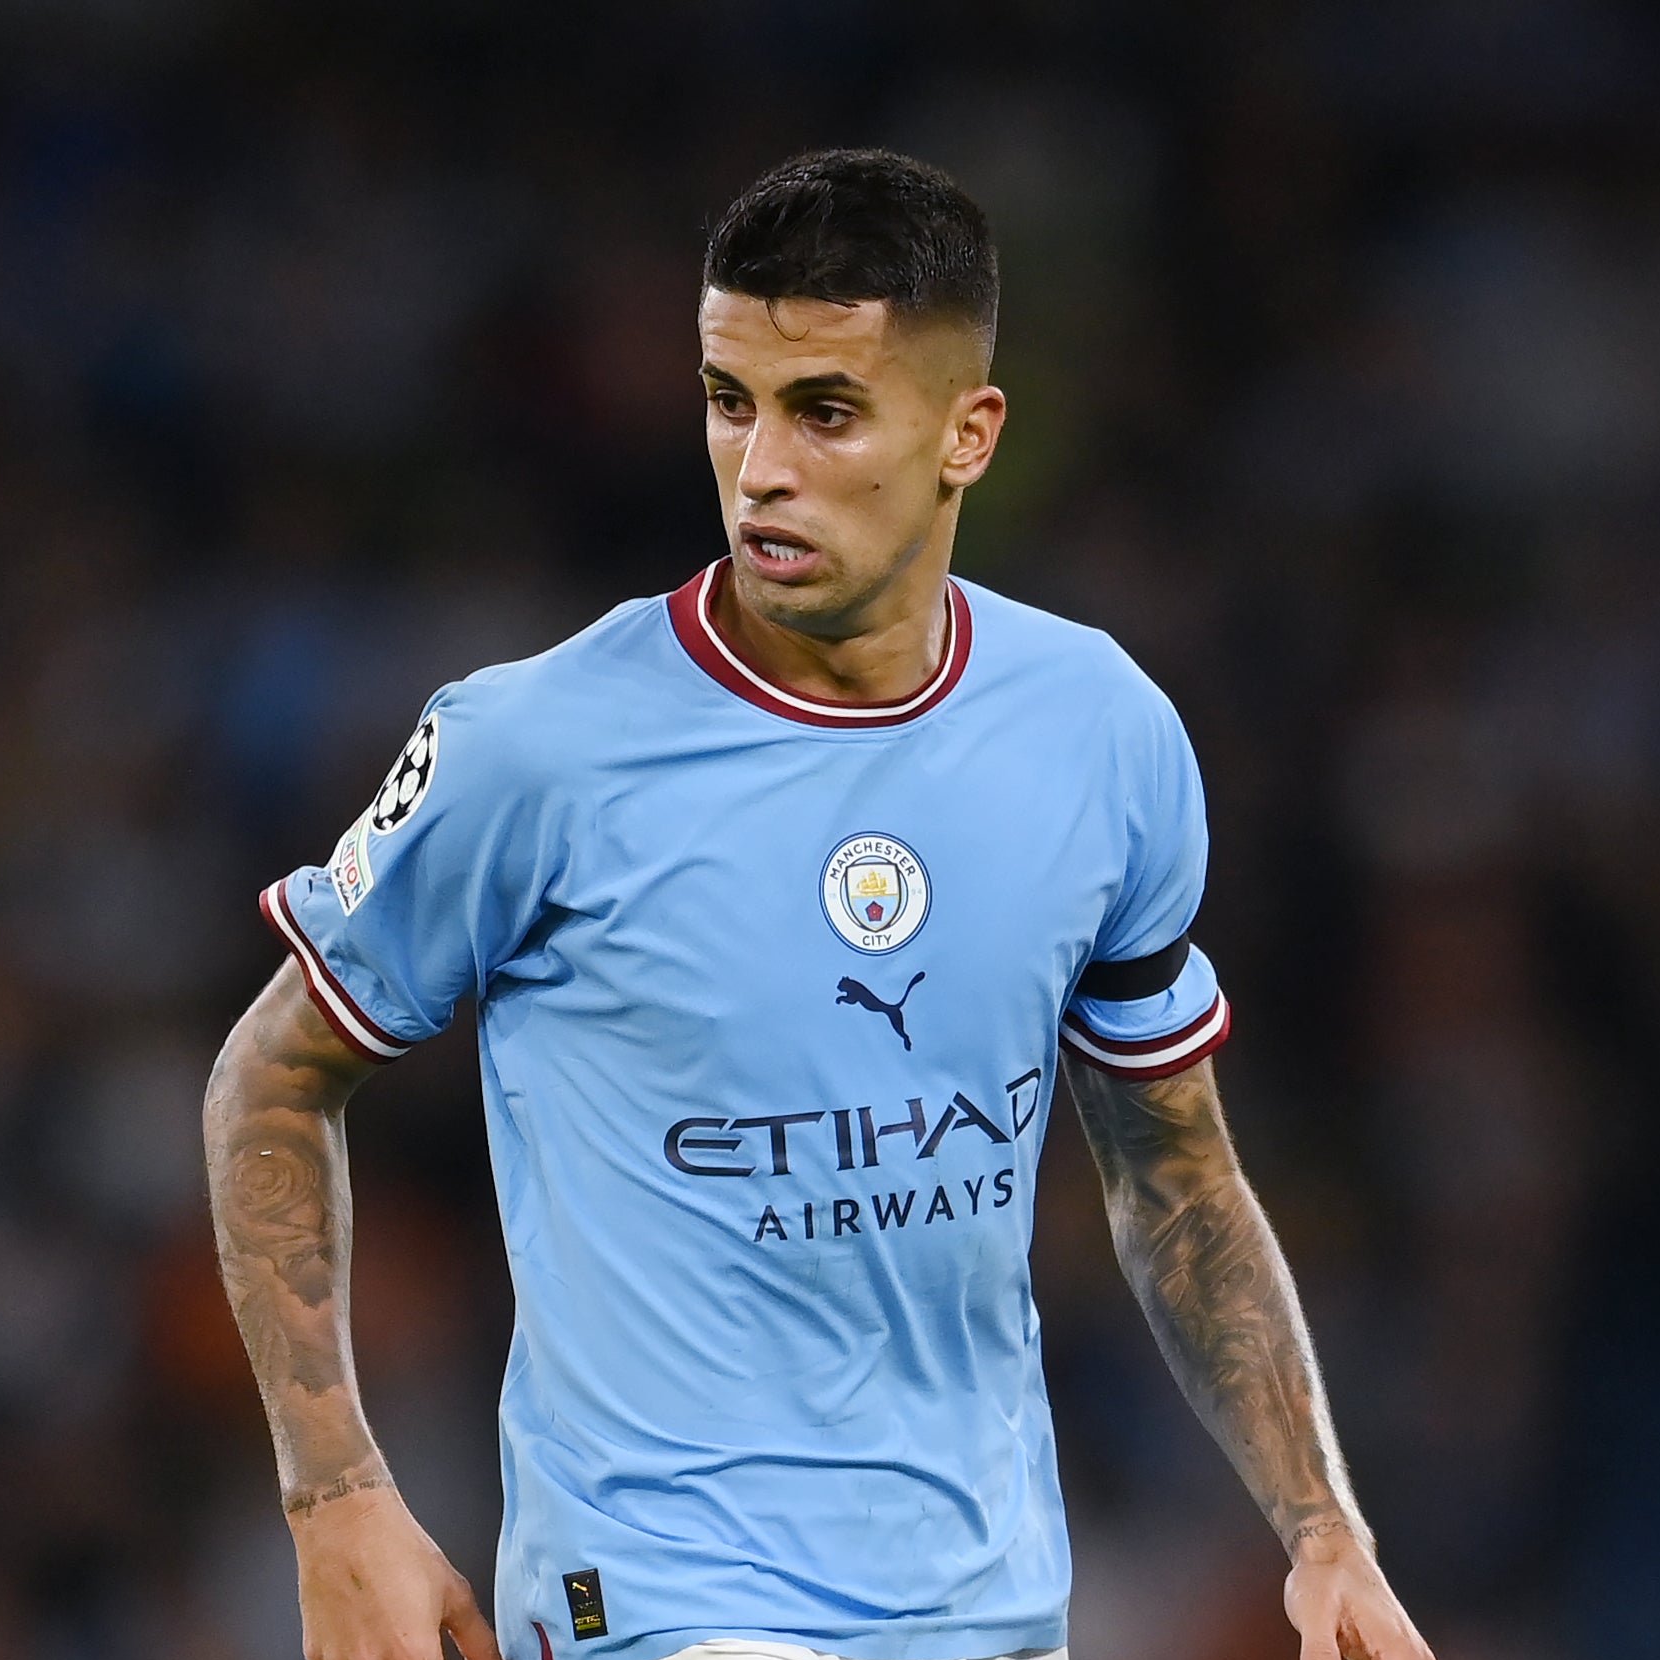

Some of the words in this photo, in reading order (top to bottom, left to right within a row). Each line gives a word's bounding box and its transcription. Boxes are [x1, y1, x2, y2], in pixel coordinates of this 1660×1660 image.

[829, 841, 916, 880] MANCHESTER
[862, 934, 892, 946] CITY
[663, 1067, 1042, 1178] ETIHAD
[754, 1168, 1015, 1243] AIRWAYS
